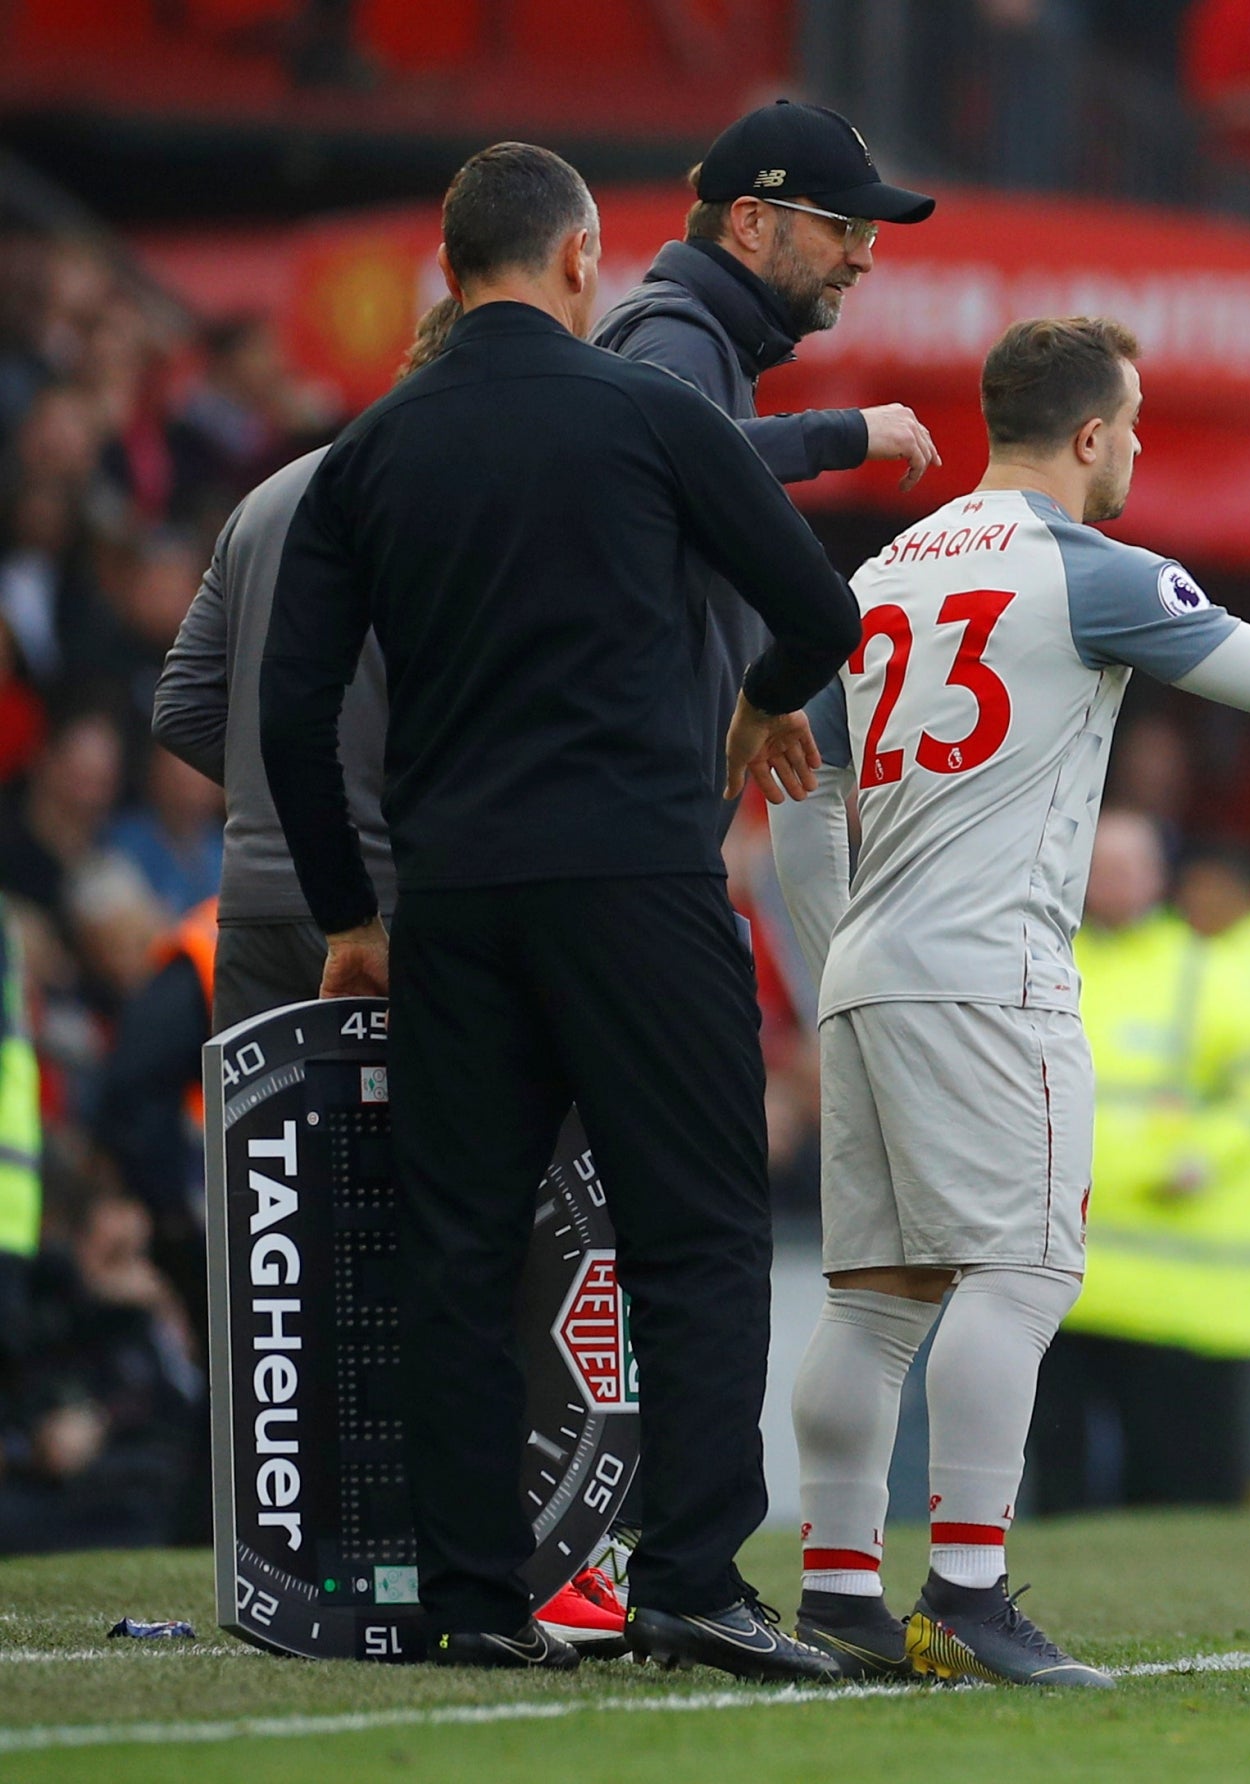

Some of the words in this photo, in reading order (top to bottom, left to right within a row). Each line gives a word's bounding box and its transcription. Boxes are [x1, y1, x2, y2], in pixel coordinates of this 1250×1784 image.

[884, 522, 1018, 566] SHAQIRI
[848, 588, 1019, 791] 23
[564, 1265, 618, 1398] HEUER
[583, 1452, 624, 1515] 05
[364, 1625, 403, 1655] 15
